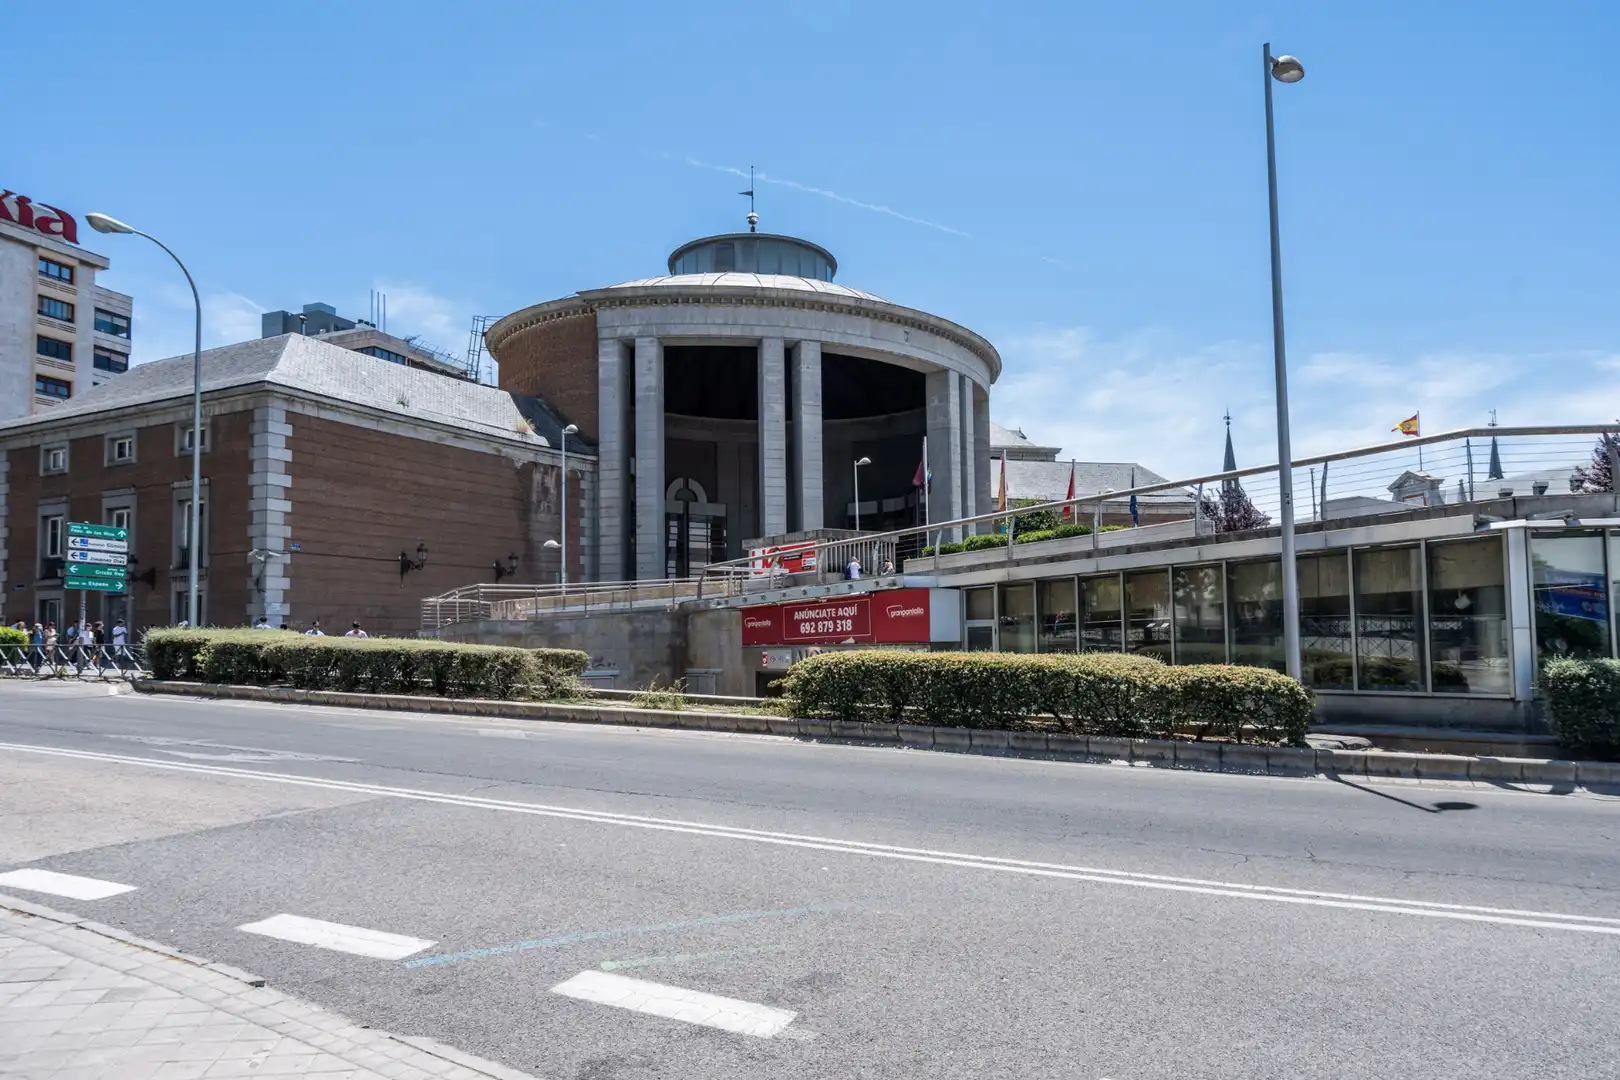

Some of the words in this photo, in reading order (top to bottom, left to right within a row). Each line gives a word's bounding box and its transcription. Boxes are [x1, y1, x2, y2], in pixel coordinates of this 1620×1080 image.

[793, 607, 836, 620] ANÚNCIATE
[837, 604, 858, 618] AQUÍ
[800, 622, 816, 634] 692
[817, 620, 834, 633] 879
[836, 619, 853, 632] 318
